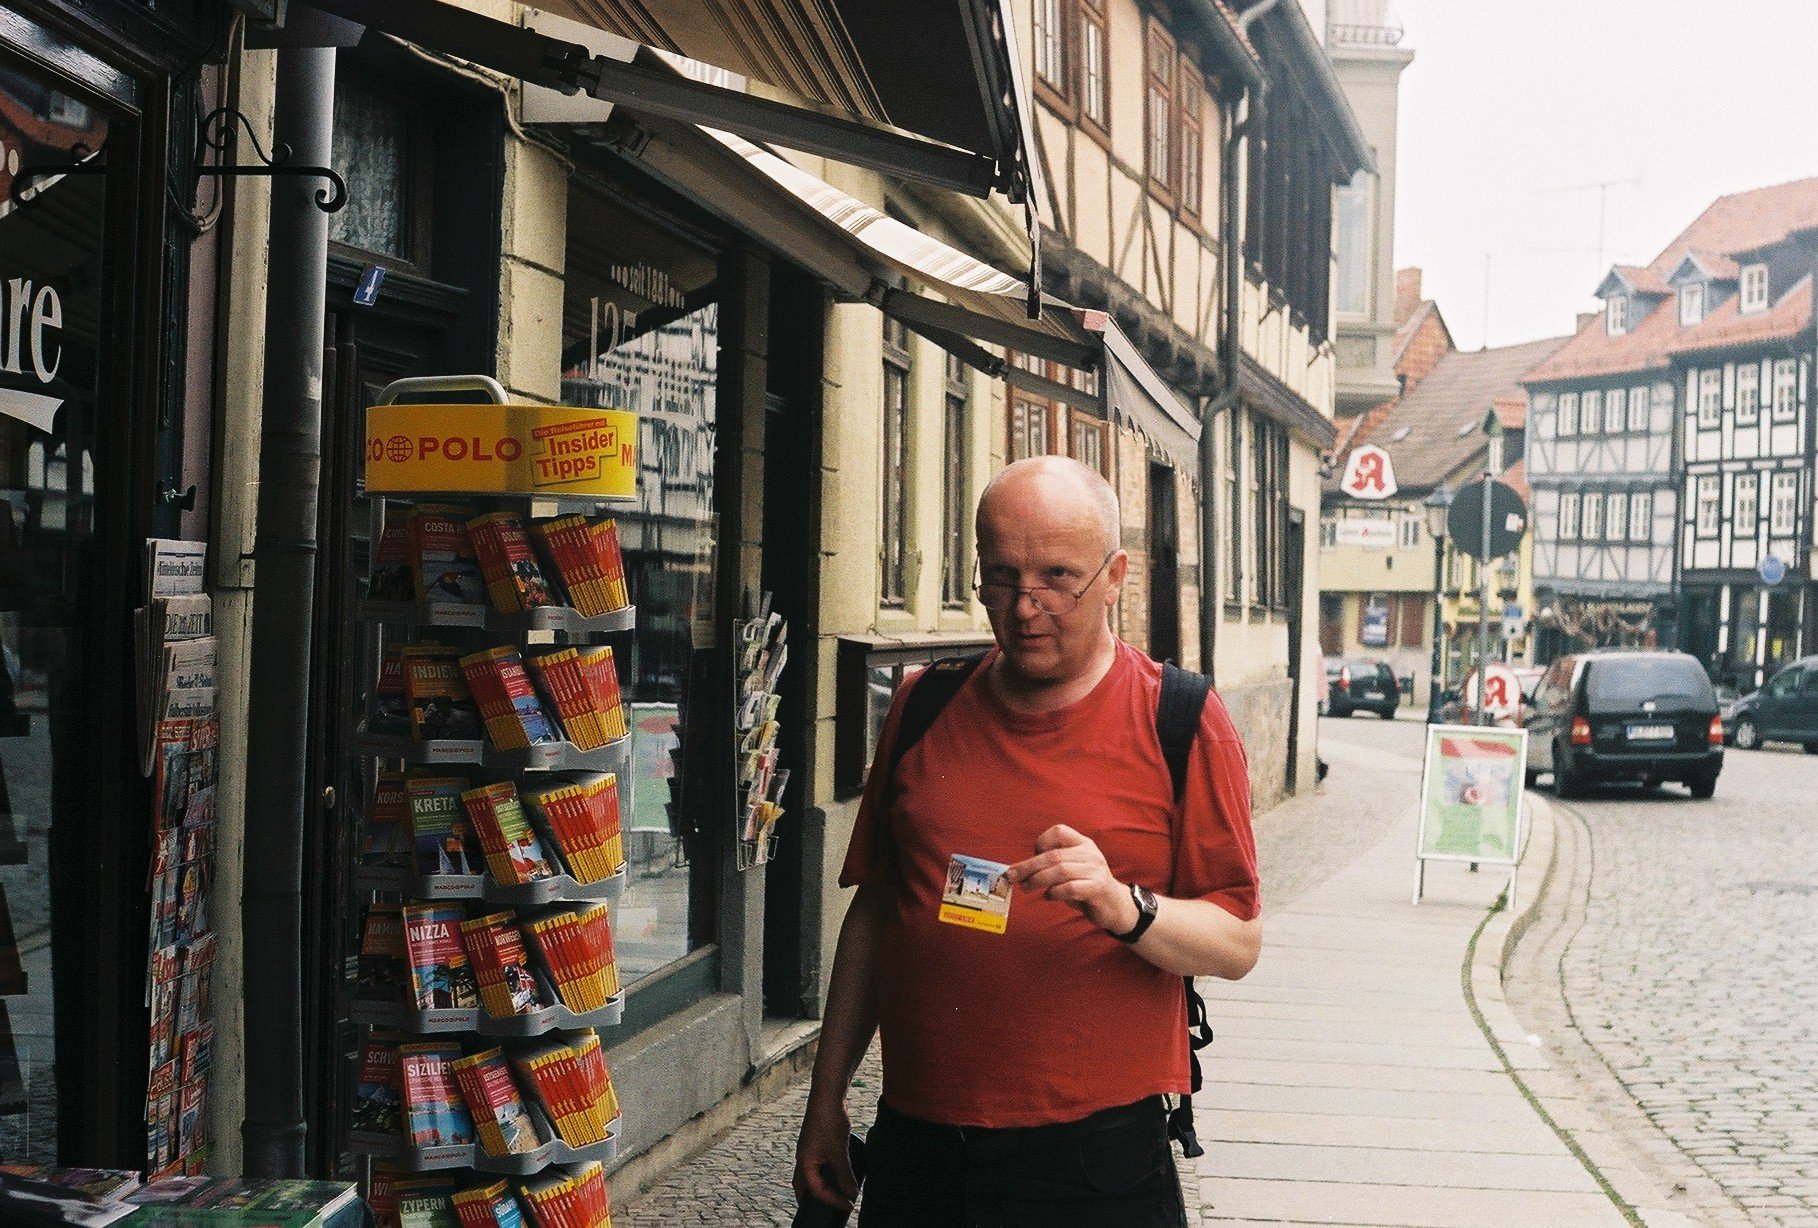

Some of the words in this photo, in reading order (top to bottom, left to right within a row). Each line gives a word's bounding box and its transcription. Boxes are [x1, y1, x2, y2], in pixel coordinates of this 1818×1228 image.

[0, 277, 62, 383] re
[418, 435, 523, 461] POLO
[549, 430, 614, 457] Insider
[536, 455, 596, 480] Tipps
[424, 521, 455, 534] COSTA
[413, 796, 458, 813] KRETA
[410, 923, 450, 942] NIZZA
[401, 1196, 446, 1211] ZYPERN
